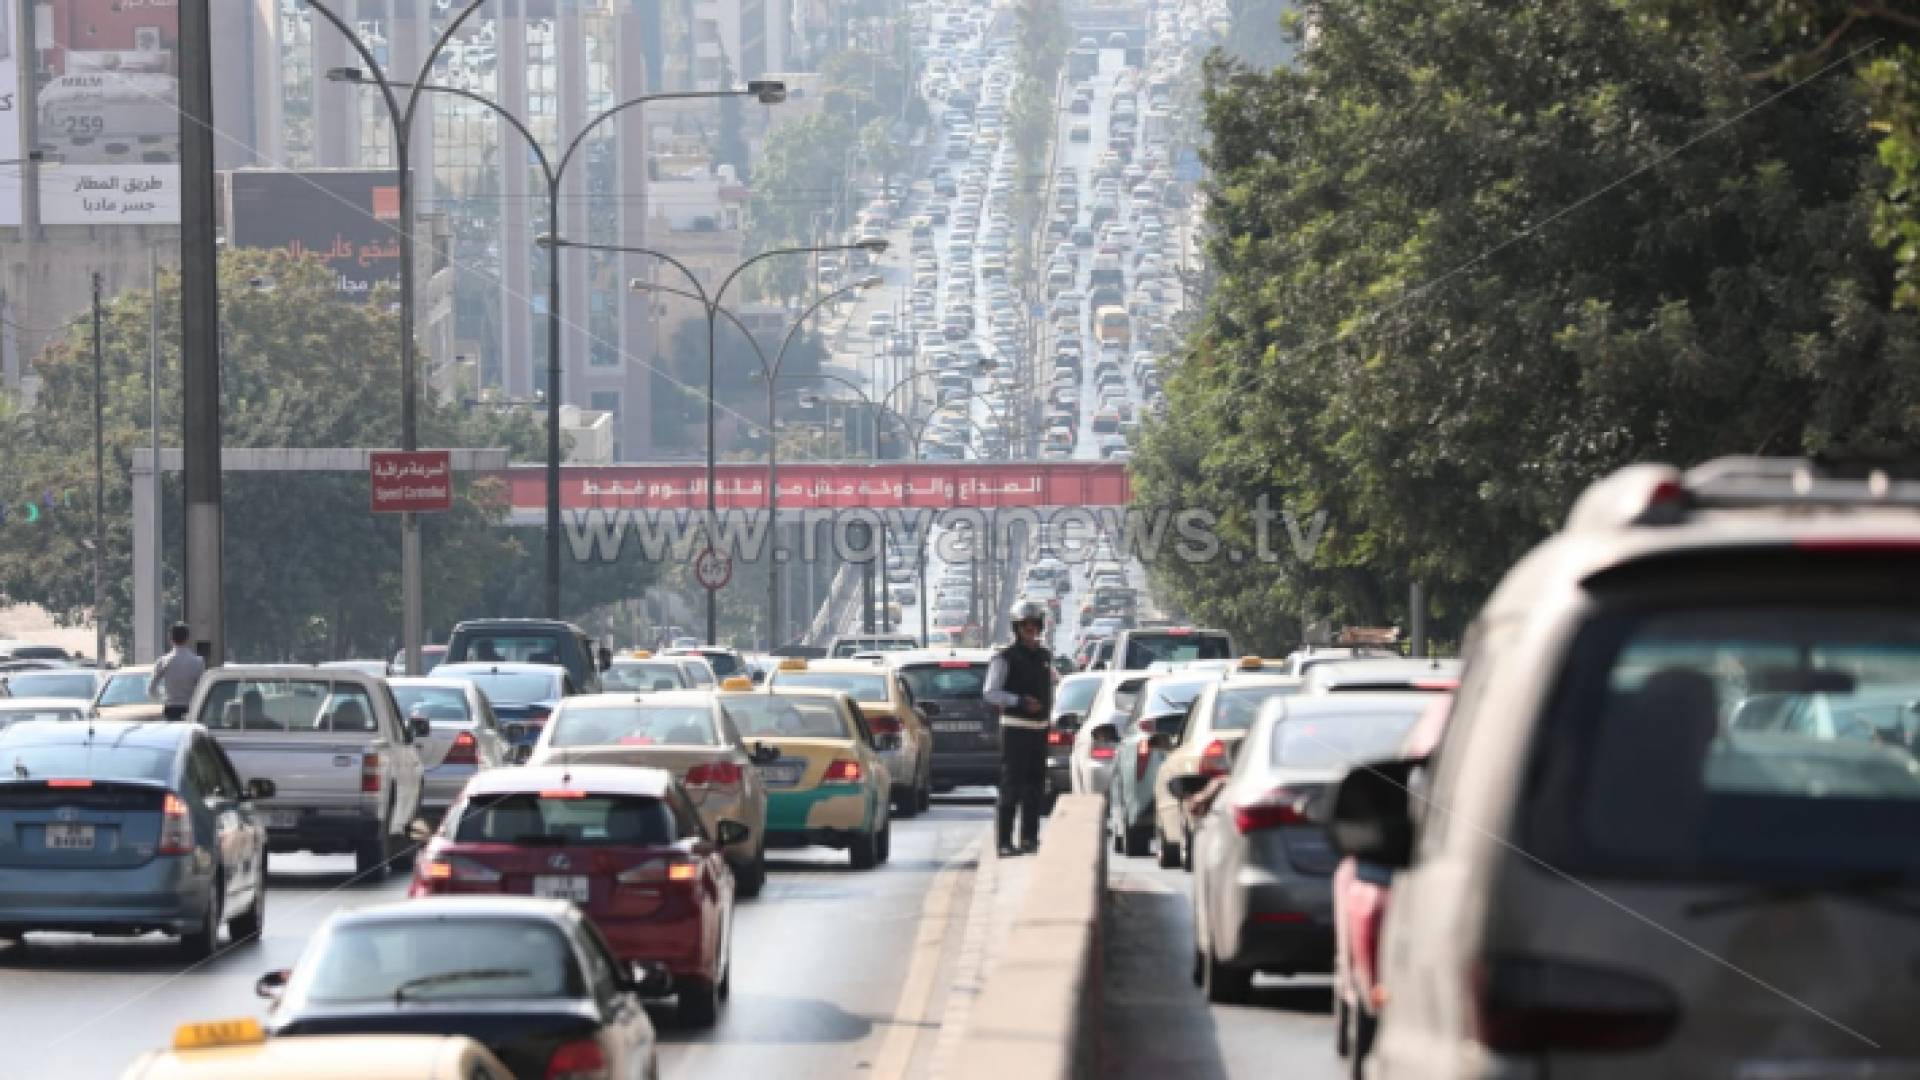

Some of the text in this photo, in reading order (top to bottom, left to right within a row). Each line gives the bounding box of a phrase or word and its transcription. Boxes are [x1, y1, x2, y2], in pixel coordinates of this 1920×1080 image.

[73, 175, 163, 194] طريق المطار
[120, 201, 156, 215] جسر
[859, 477, 954, 498] والدوخة
[960, 477, 1041, 499] الصداع
